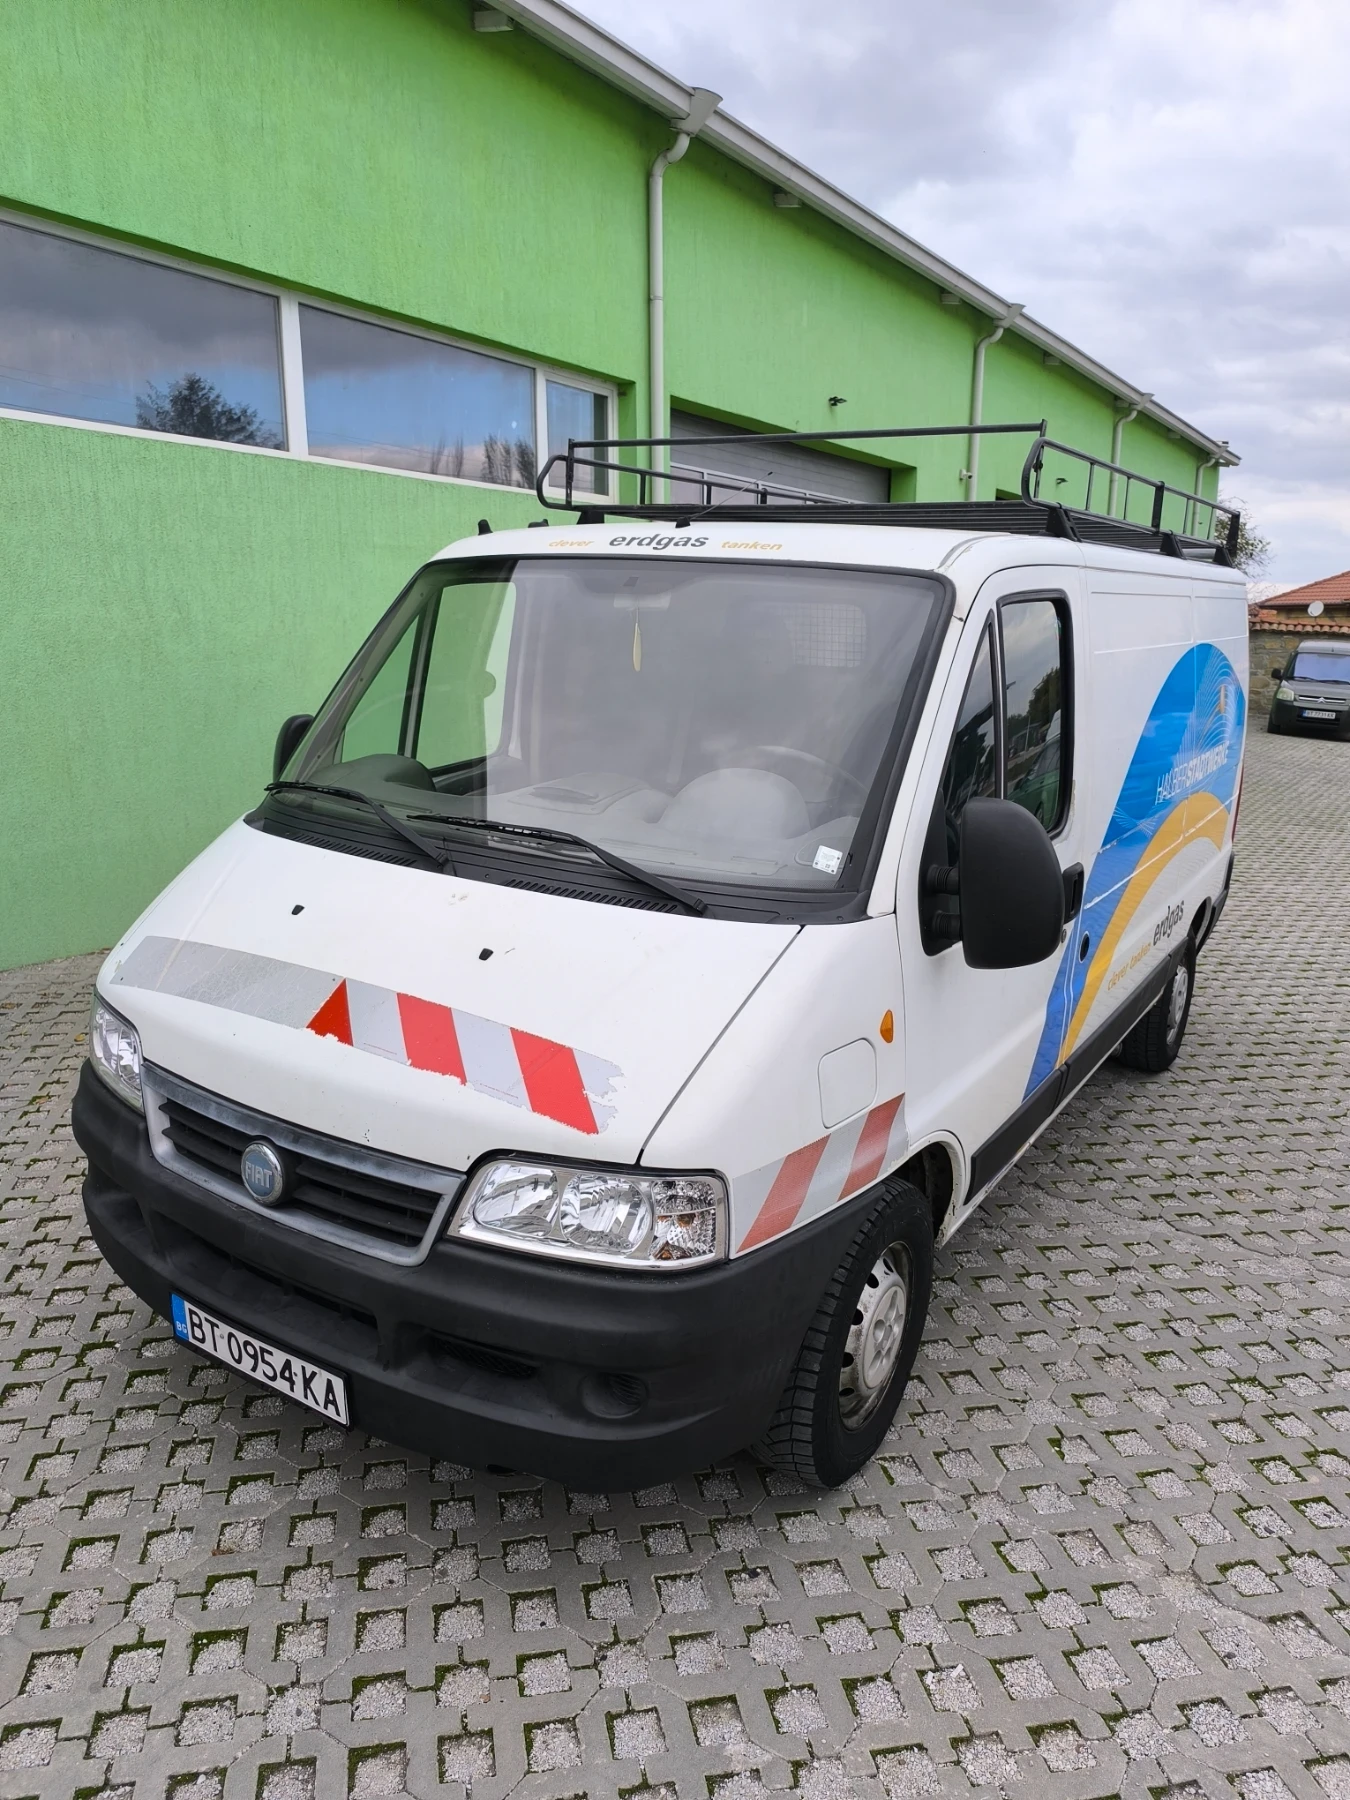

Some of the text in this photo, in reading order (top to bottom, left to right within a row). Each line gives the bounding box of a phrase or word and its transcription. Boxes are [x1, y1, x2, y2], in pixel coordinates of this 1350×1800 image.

[549, 533, 783, 551] clever erdgas tanken
[1153, 899, 1185, 947] erdgas
[245, 1160, 273, 1189] FIAT
[176, 1320, 188, 1333] BG
[188, 1307, 342, 1418] BT 0954 KA
